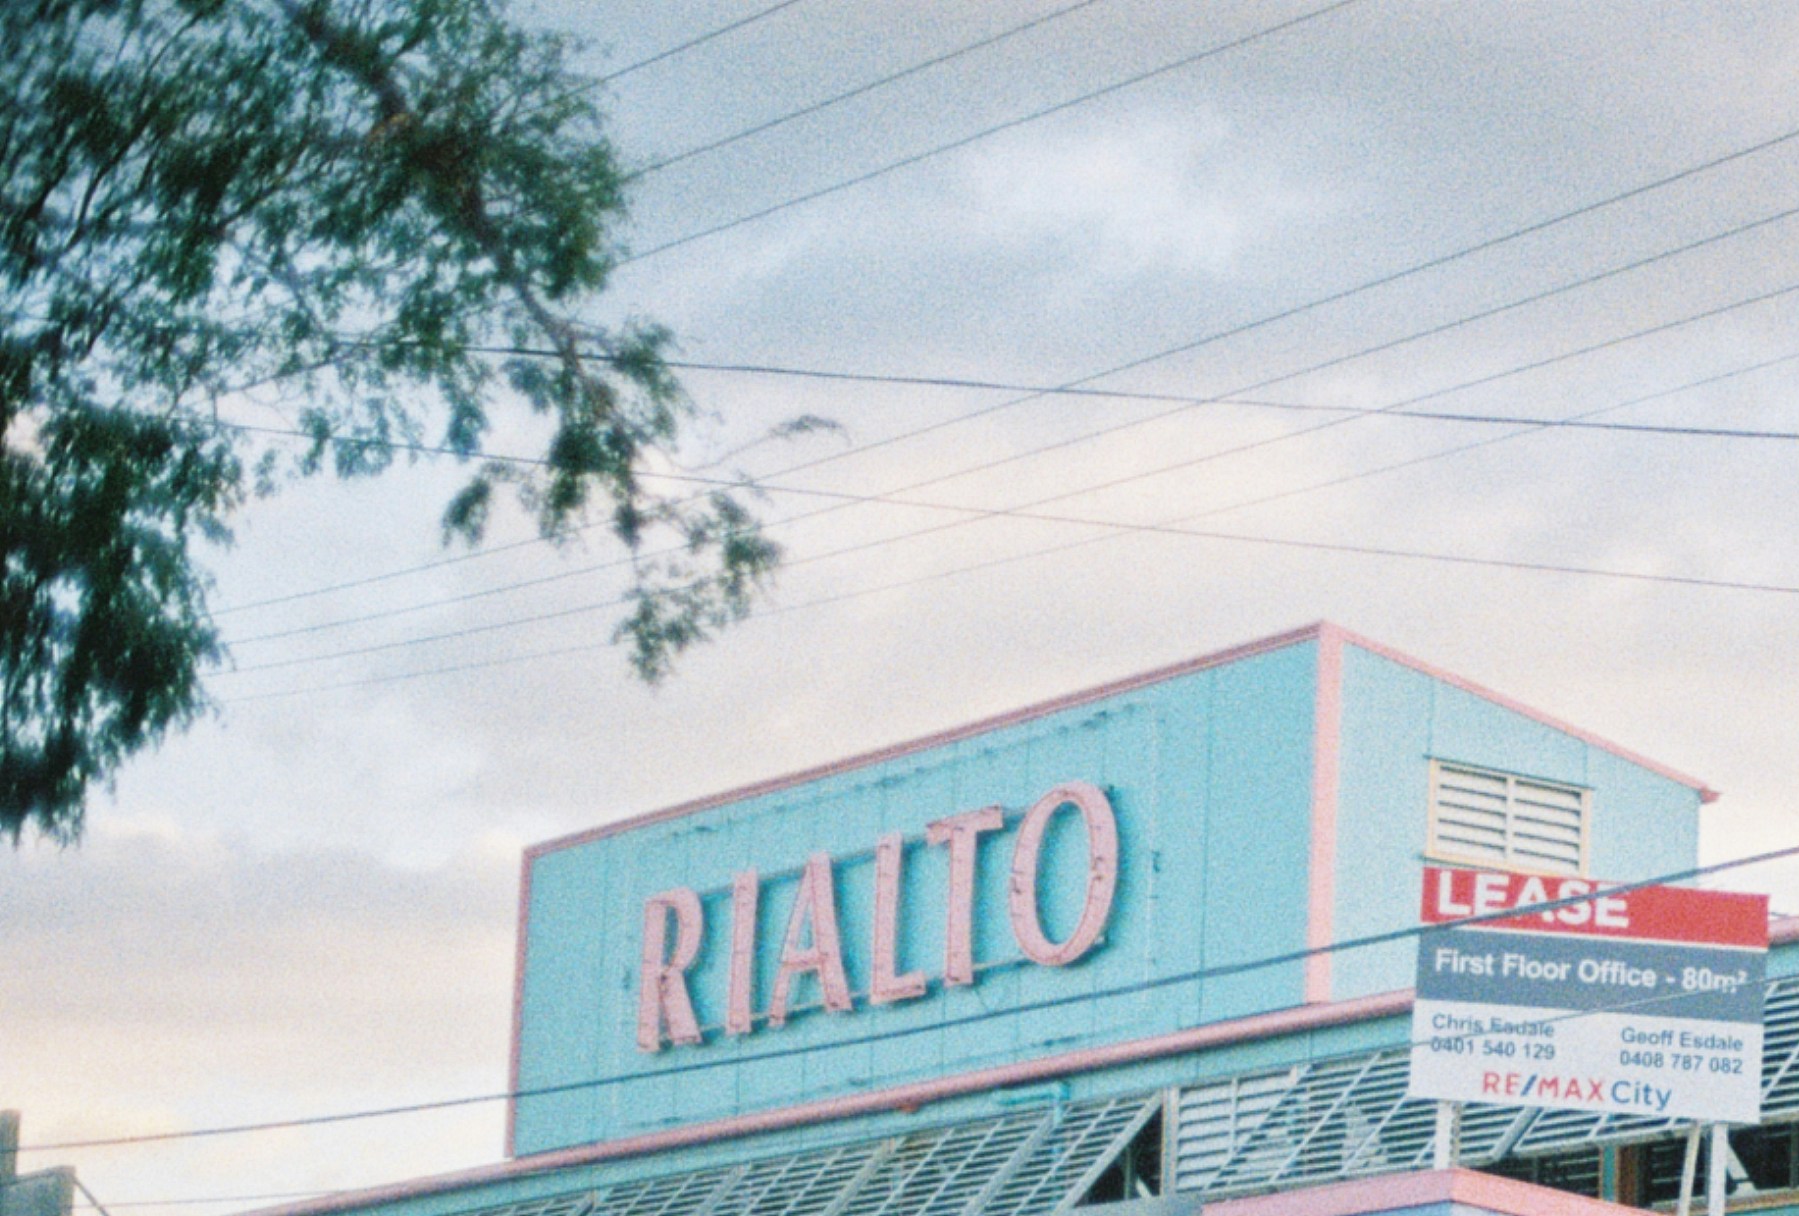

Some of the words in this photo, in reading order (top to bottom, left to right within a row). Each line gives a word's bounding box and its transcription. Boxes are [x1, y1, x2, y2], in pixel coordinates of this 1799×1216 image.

[1438, 870, 1630, 929] LEASE
[637, 781, 1119, 1053] RIALTO
[1435, 948, 1495, 977] First
[1503, 952, 1571, 981] Floor
[1578, 958, 1657, 987] Office
[1432, 1013, 1484, 1034] Chris
[1622, 1027, 1672, 1047] Geoff
[1680, 1032, 1743, 1052] Esdale
[1431, 1035, 1475, 1054] 0401
[1483, 1039, 1515, 1057] 540
[1524, 1042, 1555, 1060] 129
[1620, 1051, 1664, 1069] 0408
[1671, 1053, 1702, 1071] 787
[1710, 1056, 1743, 1074] 082
[1483, 1072, 1606, 1102] RE/MAX
[1611, 1079, 1672, 1111] City
